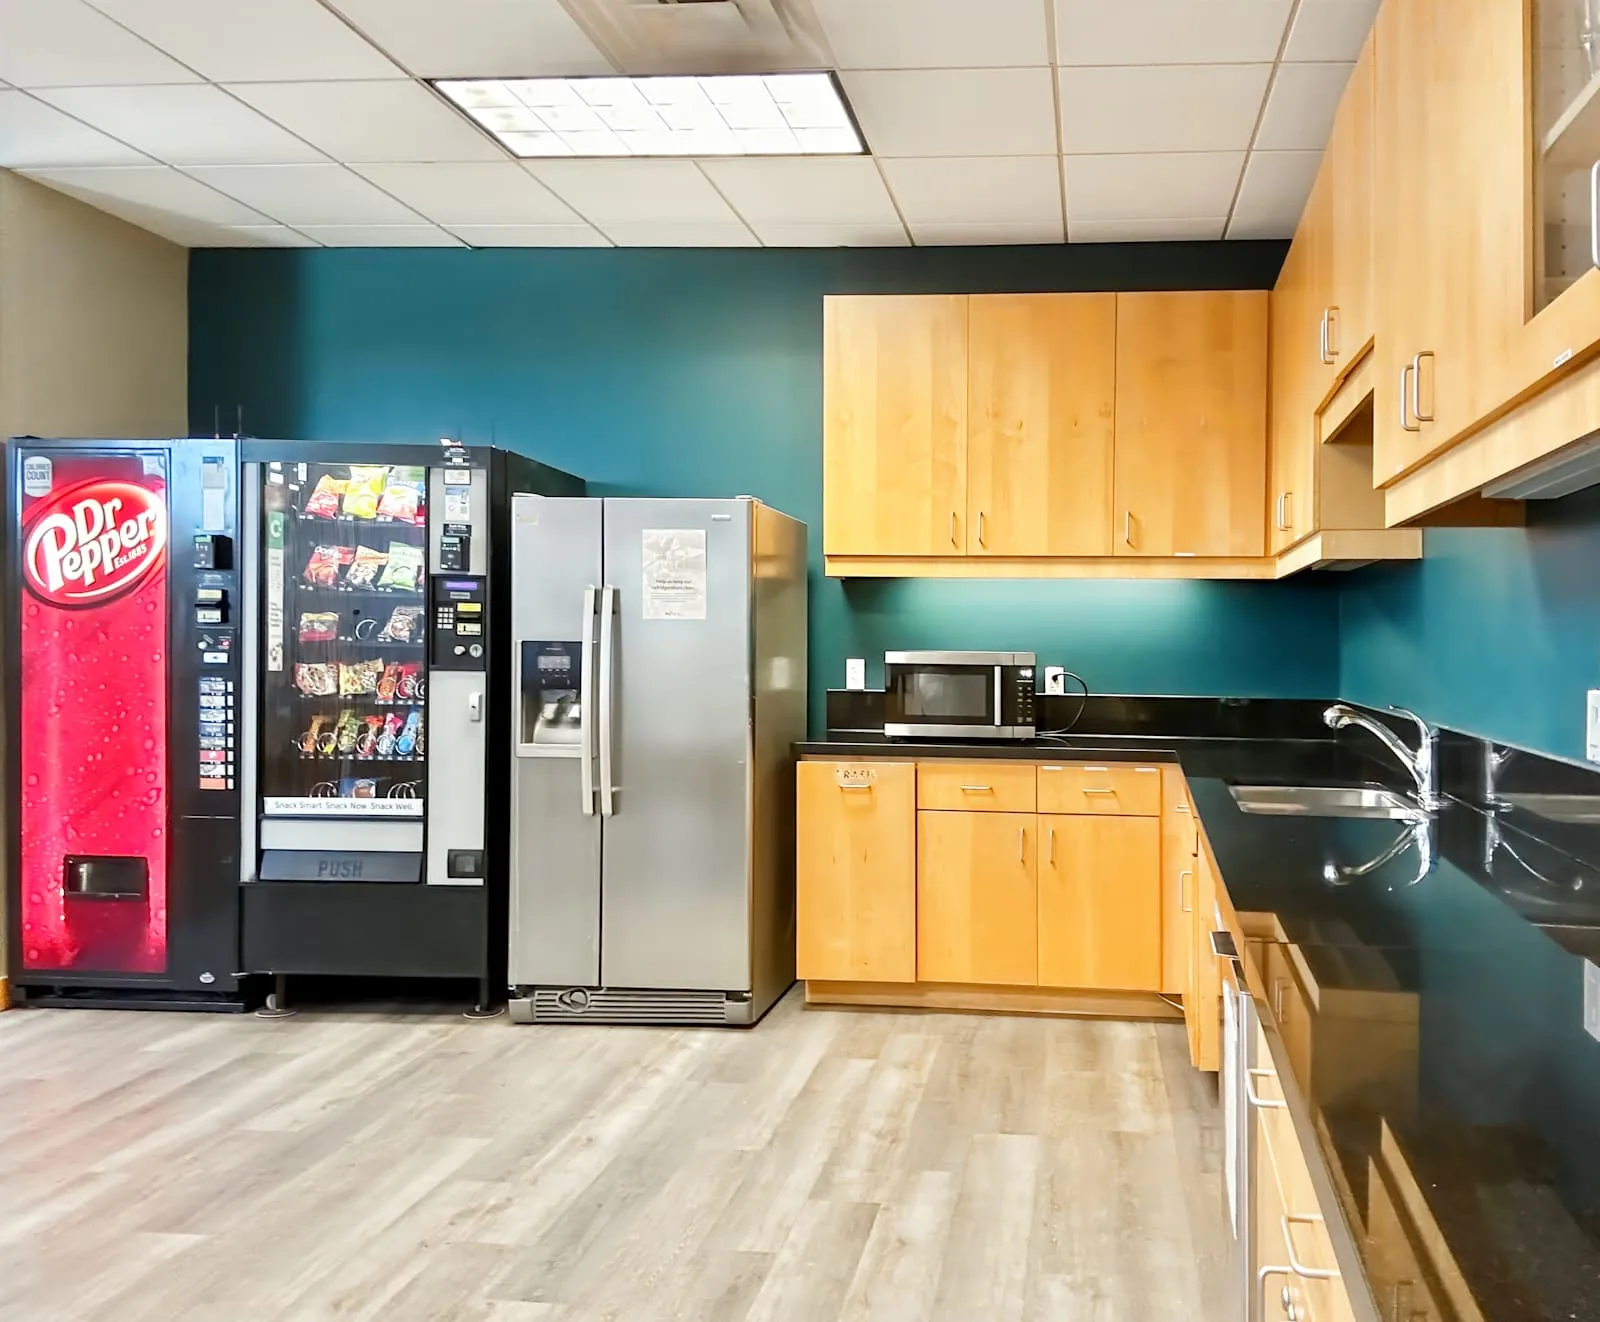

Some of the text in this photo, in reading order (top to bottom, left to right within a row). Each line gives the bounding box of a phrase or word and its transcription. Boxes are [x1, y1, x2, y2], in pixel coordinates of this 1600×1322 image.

[26, 470, 50, 480] COUNT
[72, 498, 122, 545] Dr
[29, 508, 157, 592] Pepper
[274, 801, 296, 809] Snack
[325, 801, 347, 809] Snack
[370, 802, 392, 810] Snack
[317, 859, 364, 878] PUSH
